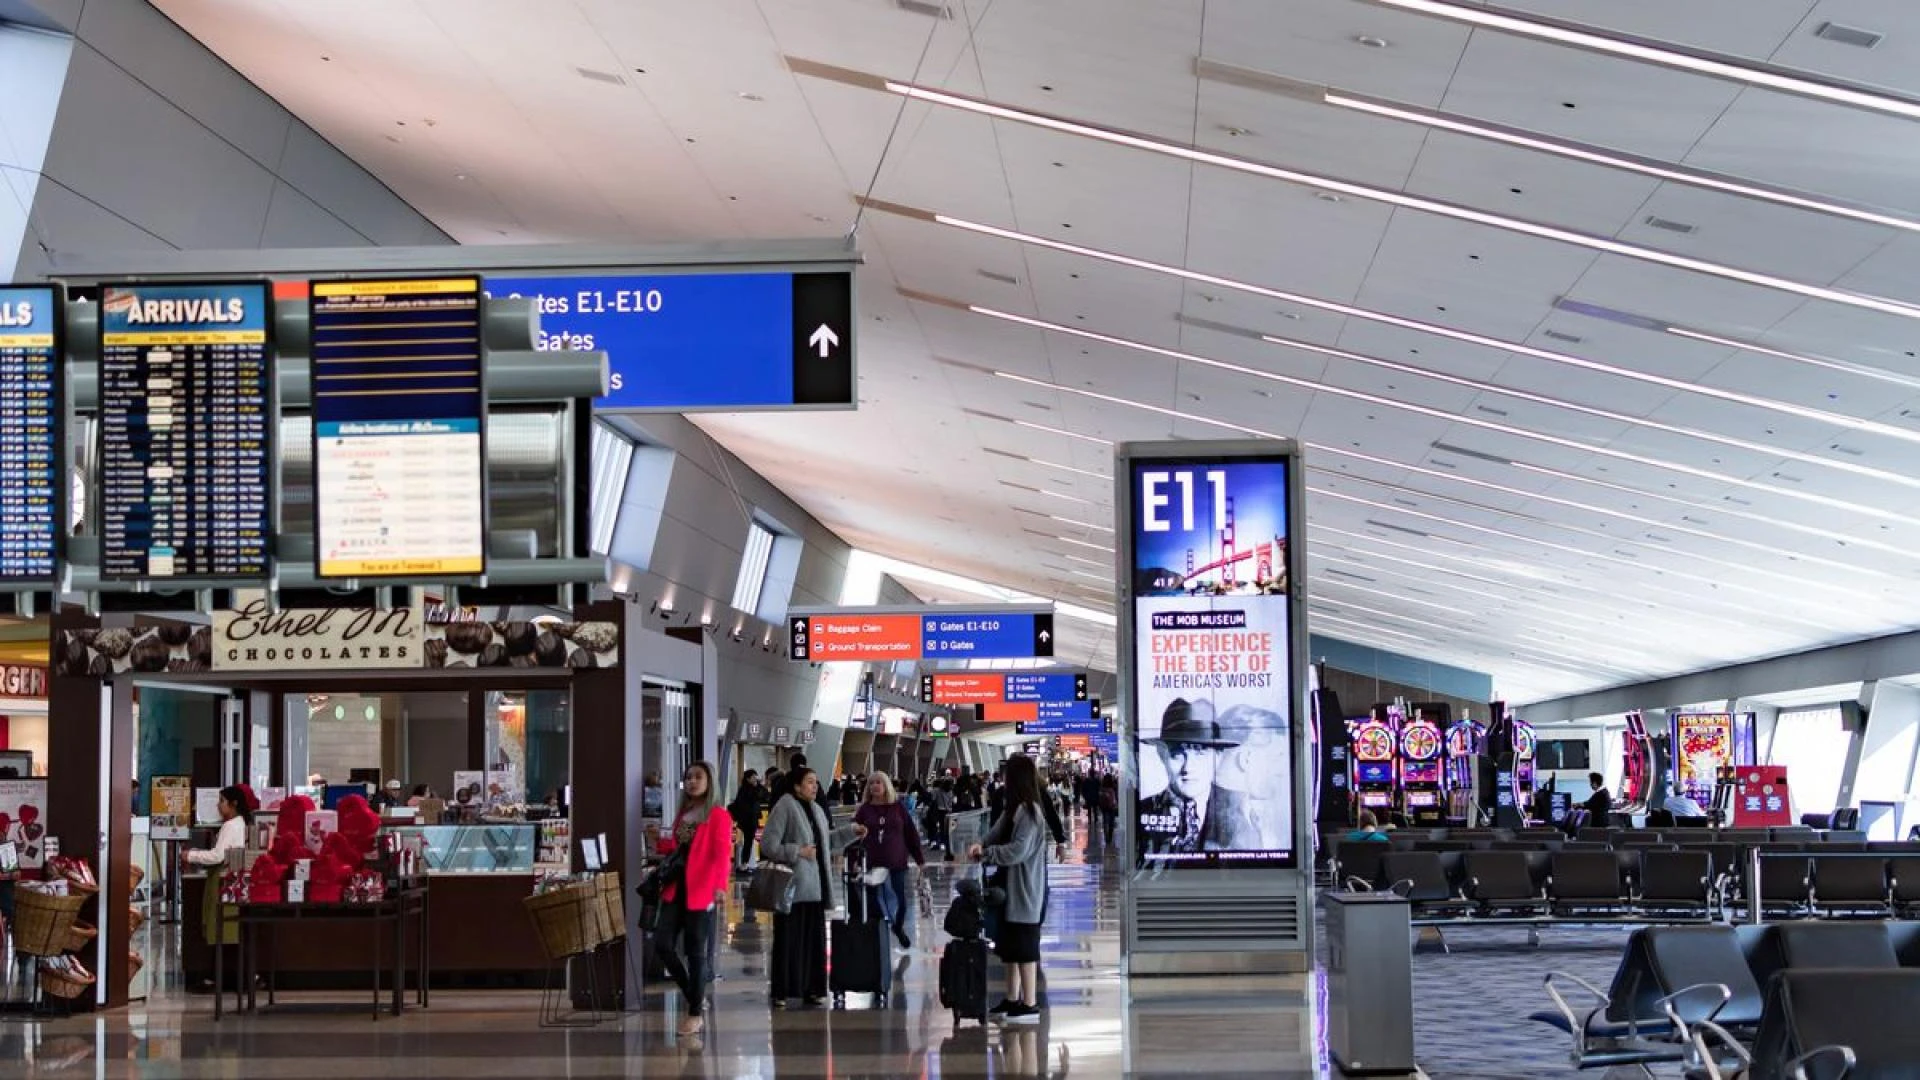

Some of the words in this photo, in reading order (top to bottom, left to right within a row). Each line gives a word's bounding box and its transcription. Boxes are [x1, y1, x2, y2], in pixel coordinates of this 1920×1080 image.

[127, 296, 244, 324] ARRIVALS
[577, 290, 662, 313] E1-E10
[0, 301, 32, 326] LS
[1143, 470, 1227, 532] E11
[1154, 577, 1166, 587] 41
[940, 622, 964, 632] Gates
[967, 621, 1000, 631] E1-E10
[1154, 616, 1174, 626] THE
[1176, 615, 1198, 625] MOB
[1201, 614, 1244, 625] MUSEUM
[827, 624, 860, 634] Baggage
[862, 624, 882, 633] Claim
[828, 642, 856, 652] Ground
[857, 642, 911, 652] Transportation
[940, 641, 948, 650] D
[950, 640, 974, 650] Gates
[1152, 632, 1272, 654] EXPERIENCE
[228, 645, 408, 662] CHOCOLATES
[1152, 655, 1188, 673] THE
[1194, 654, 1241, 673] BEST
[1248, 654, 1272, 672] OF
[1152, 672, 1222, 689] AMERICA'S
[1226, 672, 1272, 688] WORST
